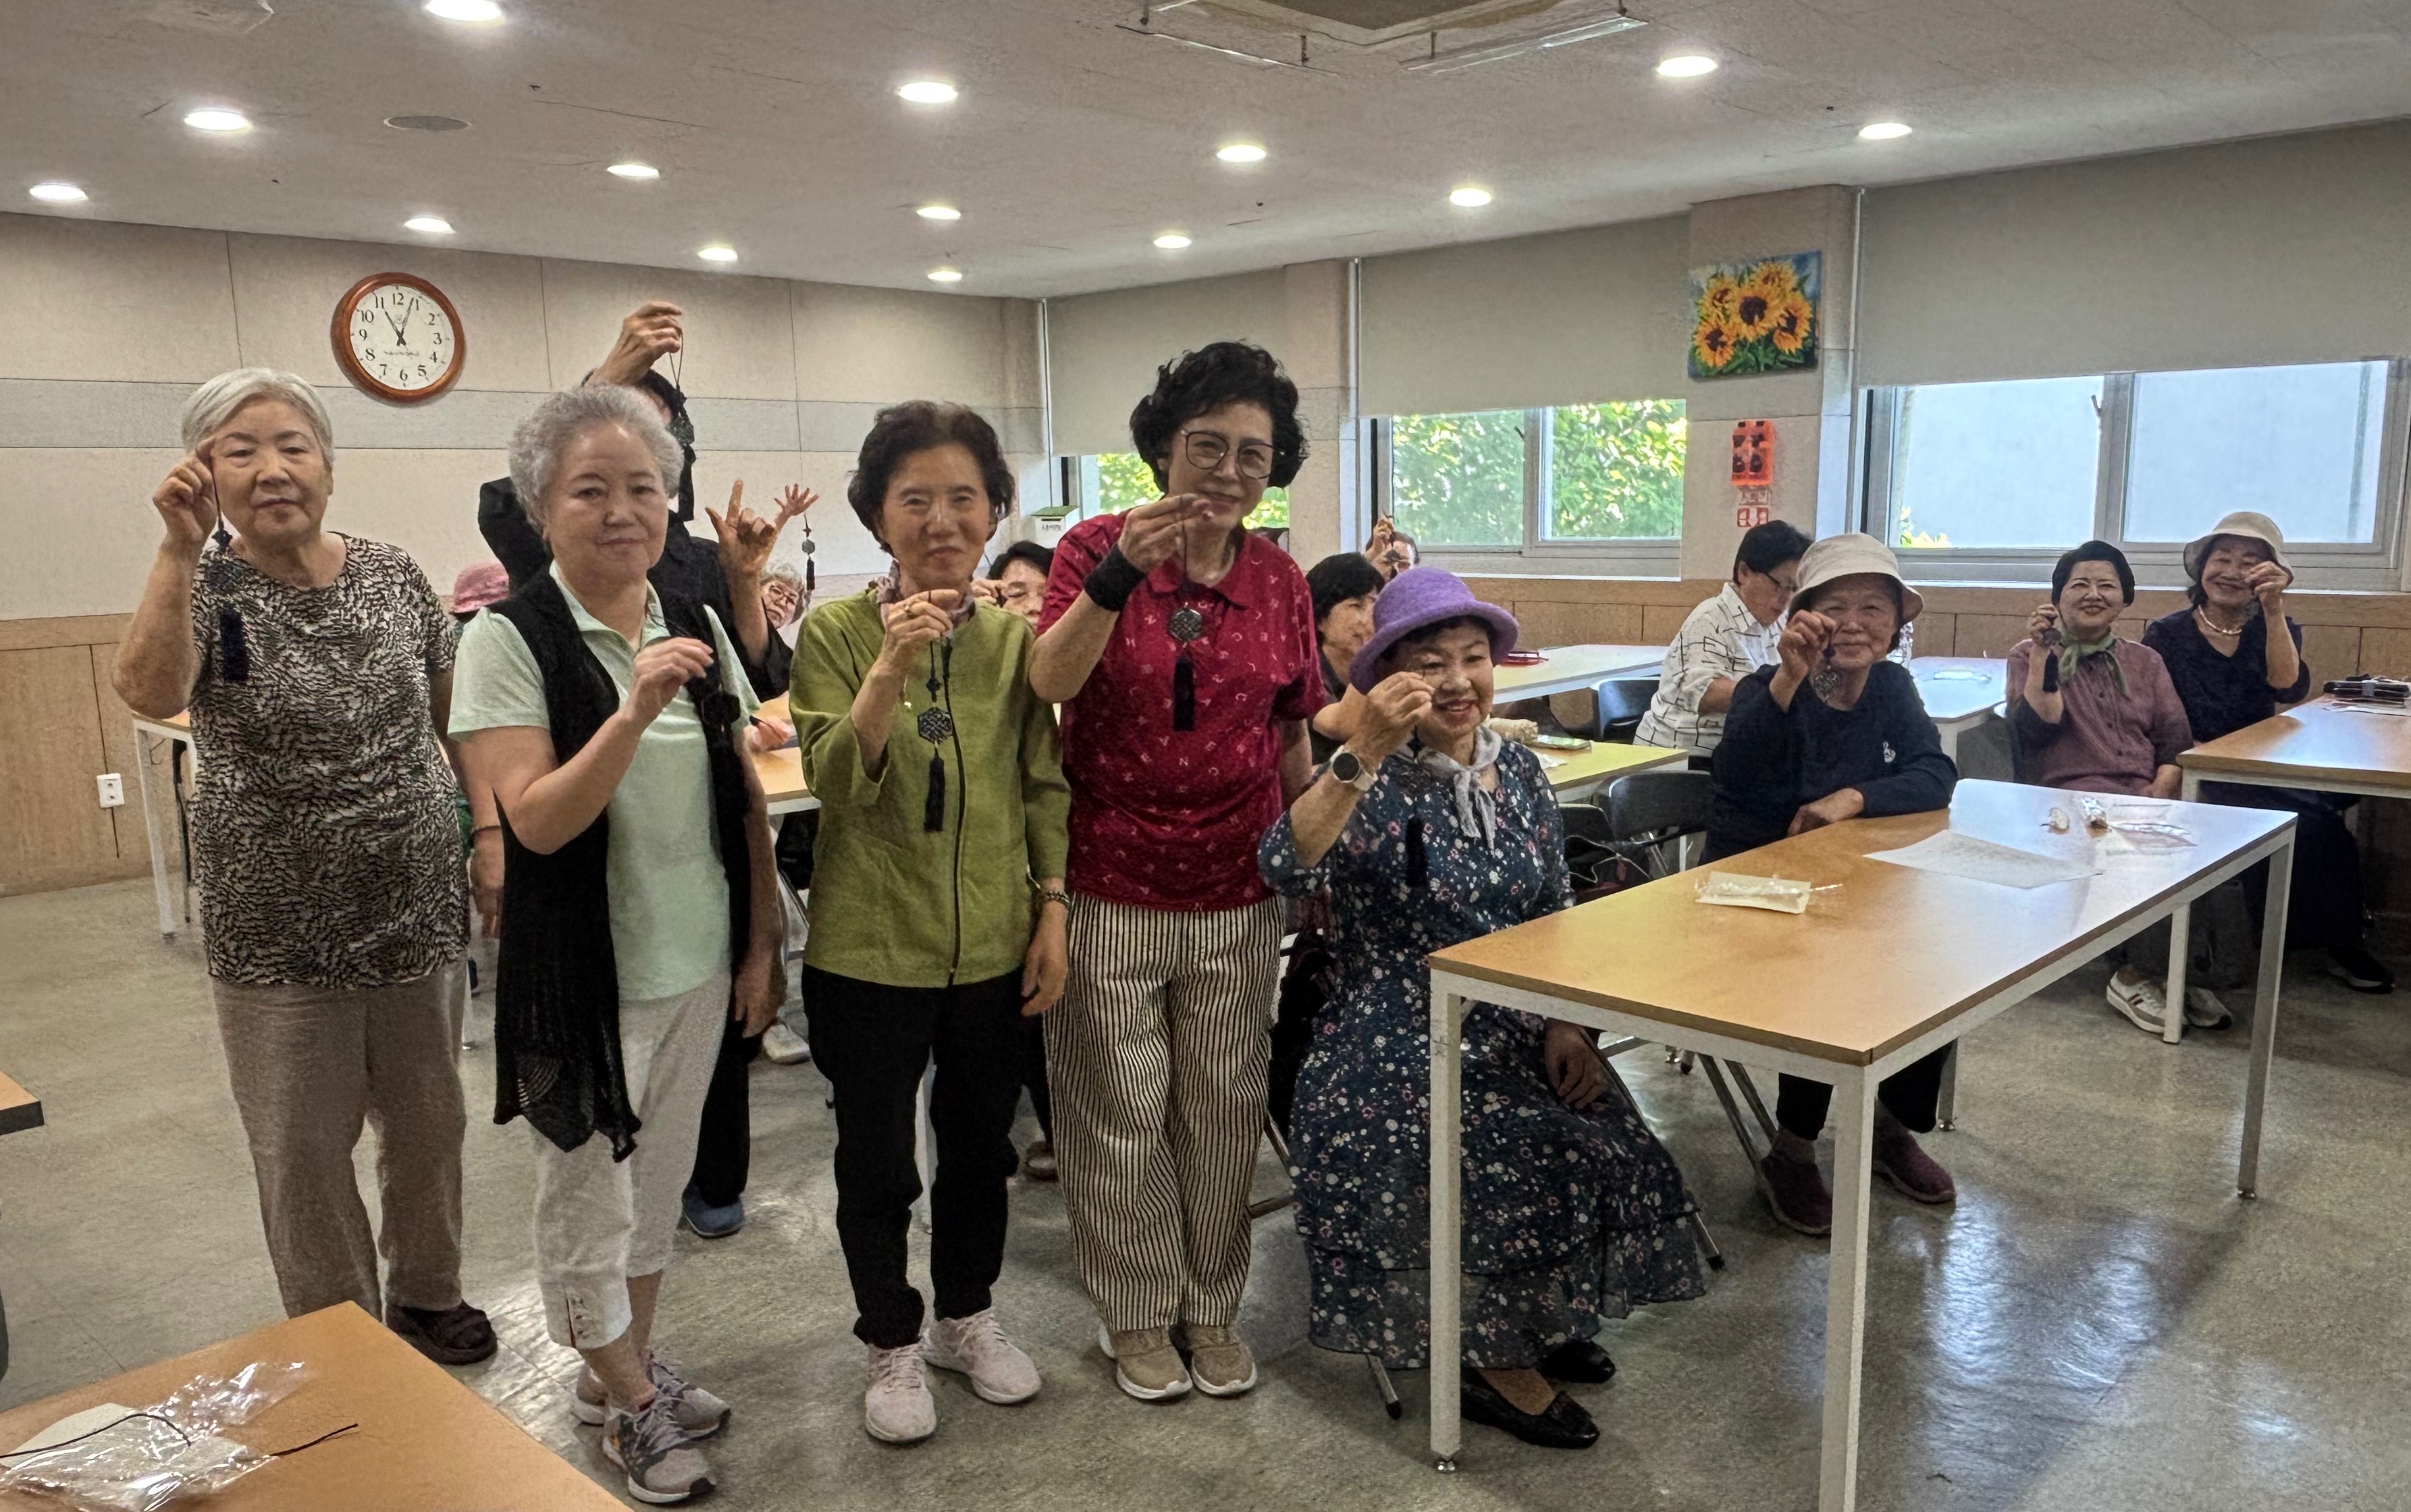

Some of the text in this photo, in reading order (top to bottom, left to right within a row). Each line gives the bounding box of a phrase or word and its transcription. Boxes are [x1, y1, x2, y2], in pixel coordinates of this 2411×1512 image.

[375, 296, 384, 308] 11
[393, 292, 404, 305] 12
[416, 298, 419, 310] 1
[361, 310, 374, 323] 10
[427, 313, 435, 325] 2
[359, 329, 367, 341] 9
[433, 332, 442, 345] 3
[365, 348, 375, 361] 8
[429, 350, 438, 363] 4
[379, 364, 388, 376] 7
[400, 369, 408, 381] 6
[417, 364, 427, 377] 5
